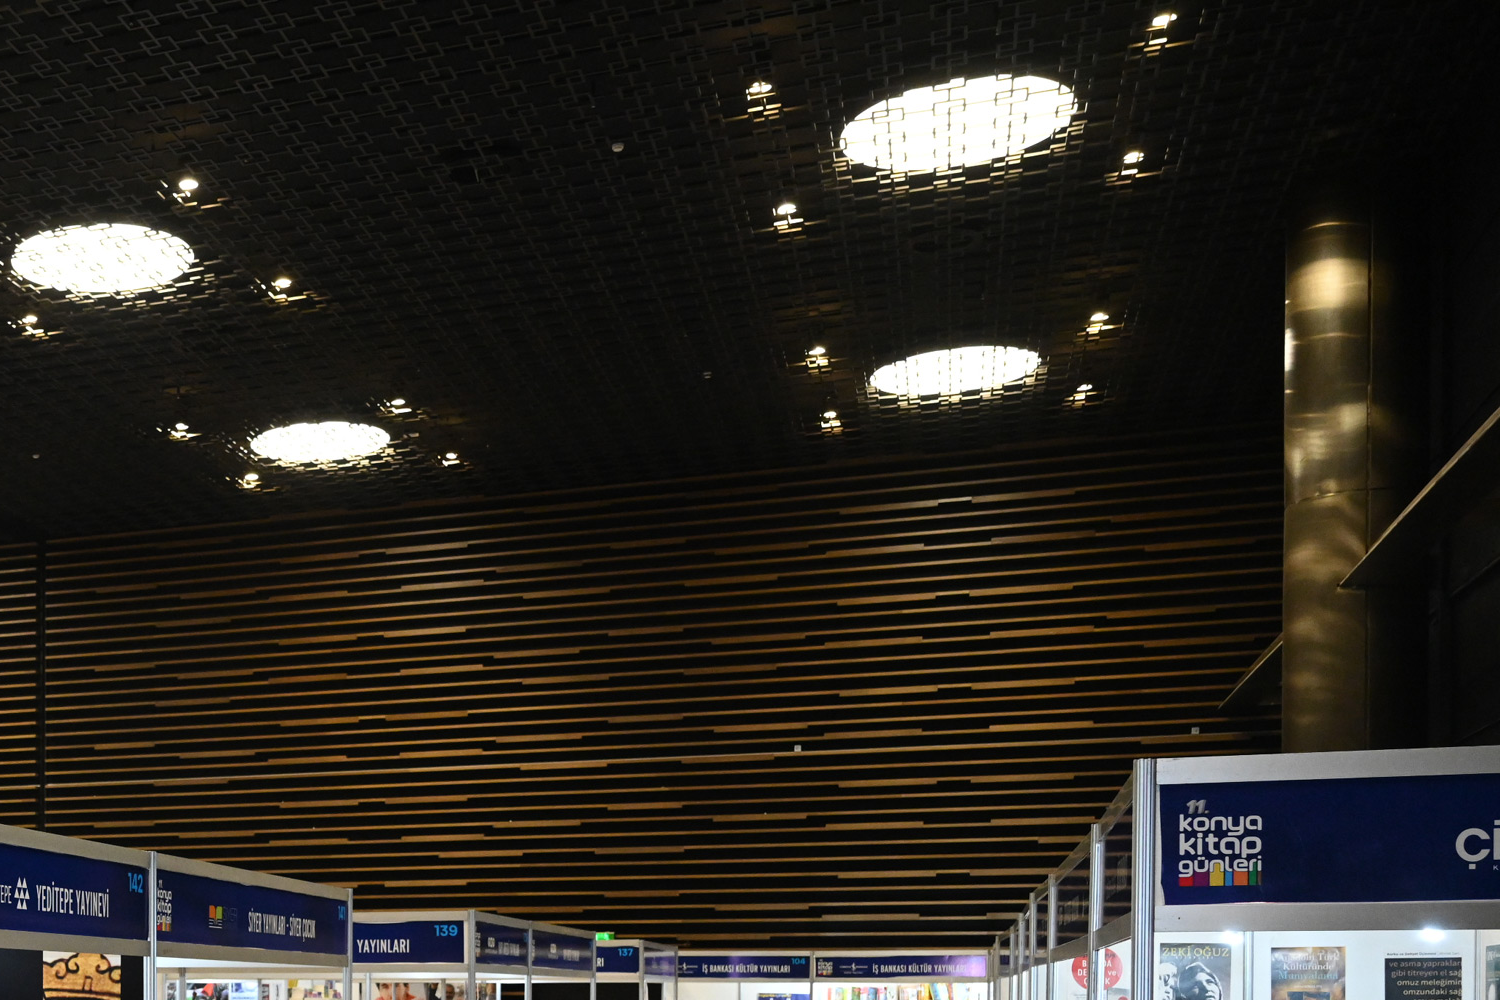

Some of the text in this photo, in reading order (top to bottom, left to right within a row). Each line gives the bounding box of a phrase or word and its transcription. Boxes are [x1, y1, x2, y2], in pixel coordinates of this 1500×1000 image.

[1186, 799, 1209, 815] 11.
[1179, 814, 1262, 836] konya
[1179, 833, 1262, 859] kitap
[1179, 856, 1262, 877] günleri
[128, 872, 144, 894] 142
[36, 881, 110, 918] YEDİTEPE YAYINEVİ
[248, 907, 262, 933] SİYER
[263, 913, 286, 935] YAYINLARI
[289, 913, 302, 937] SİYER
[302, 918, 316, 942] ÇOCUK
[434, 925, 458, 937] 139
[357, 939, 410, 953] YAYINLARI
[618, 948, 633, 957] 137
[1162, 944, 1229, 957] ZEKİ OĞUZ
[709, 964, 734, 973] BANKASI
[736, 963, 758, 973] KÜLTÜR
[760, 964, 791, 973] YAYINLARI
[791, 957, 806, 965] 104
[880, 964, 906, 973] BANKASI
[908, 963, 932, 973] KÜLTÜR
[1391, 970, 1406, 978] gibi
[1407, 970, 1438, 978] titreyen
